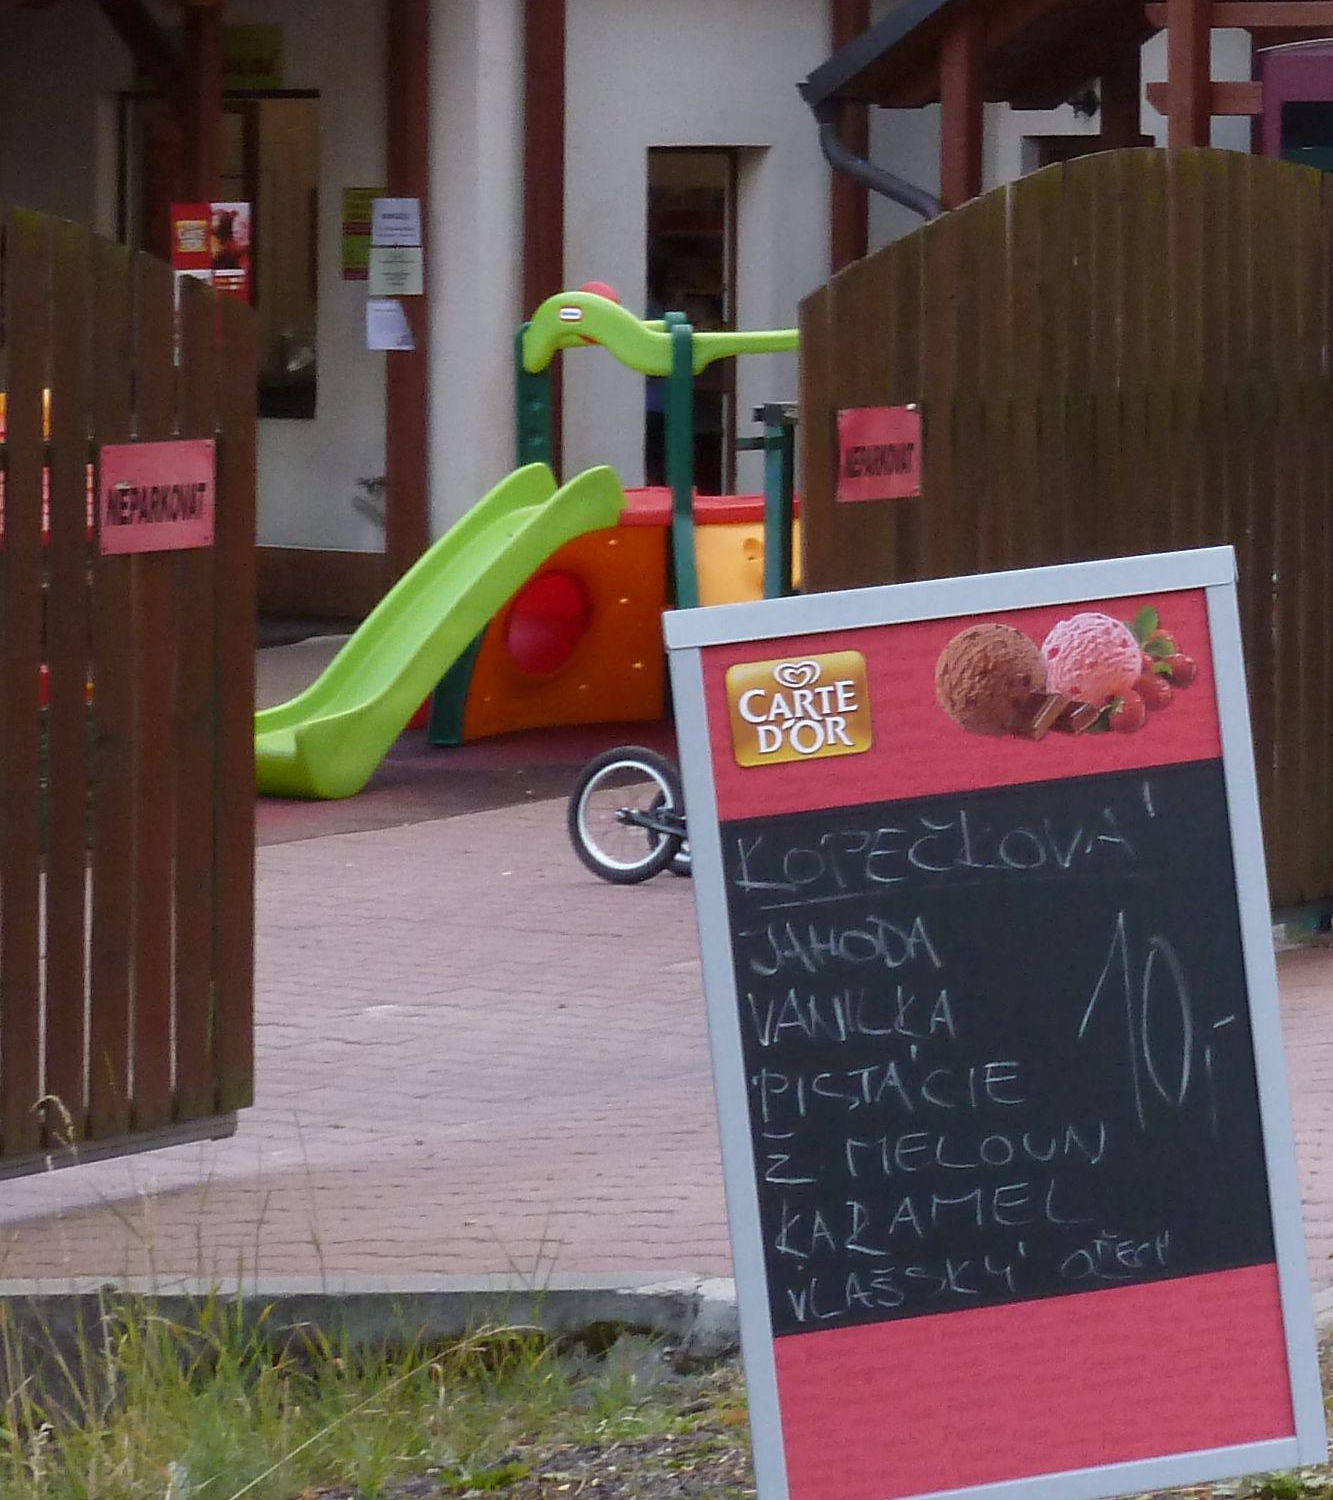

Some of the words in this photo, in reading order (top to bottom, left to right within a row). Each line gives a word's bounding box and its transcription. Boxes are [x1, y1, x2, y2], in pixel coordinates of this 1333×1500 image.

[738, 679, 859, 724] CARTE
[757, 715, 857, 755] D'OR
[740, 915, 943, 977] JAHODA
[747, 983, 957, 1047] VANILKA
[846, 1121, 1106, 1178] MELOUN
[774, 1178, 1095, 1259] KARAMEL
